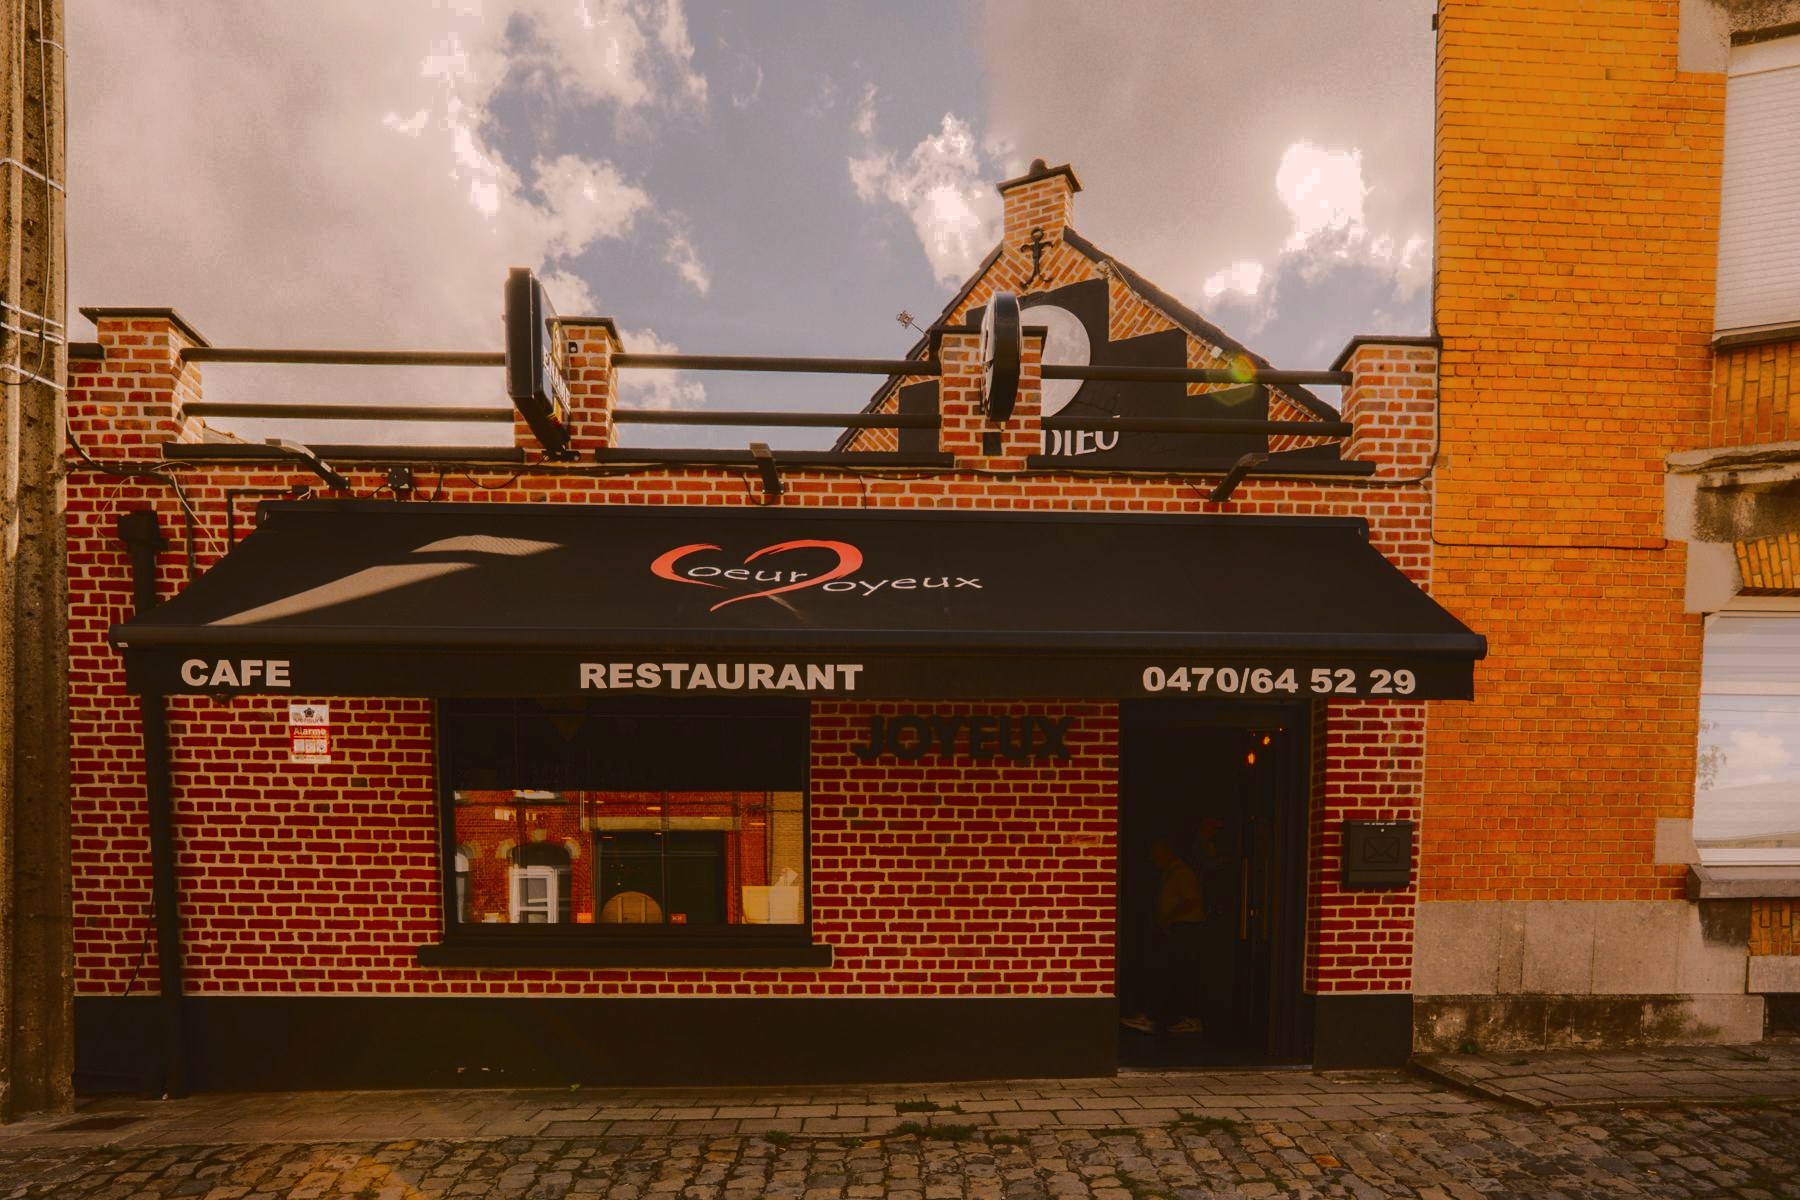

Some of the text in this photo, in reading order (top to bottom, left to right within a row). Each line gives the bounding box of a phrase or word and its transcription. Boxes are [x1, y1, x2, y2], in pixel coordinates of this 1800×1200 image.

[181, 658, 291, 687] CAFE
[579, 662, 864, 691] RESTAURANT
[1142, 666, 1416, 695] 0470/64 52 29
[855, 715, 1075, 761] JOYEUX
